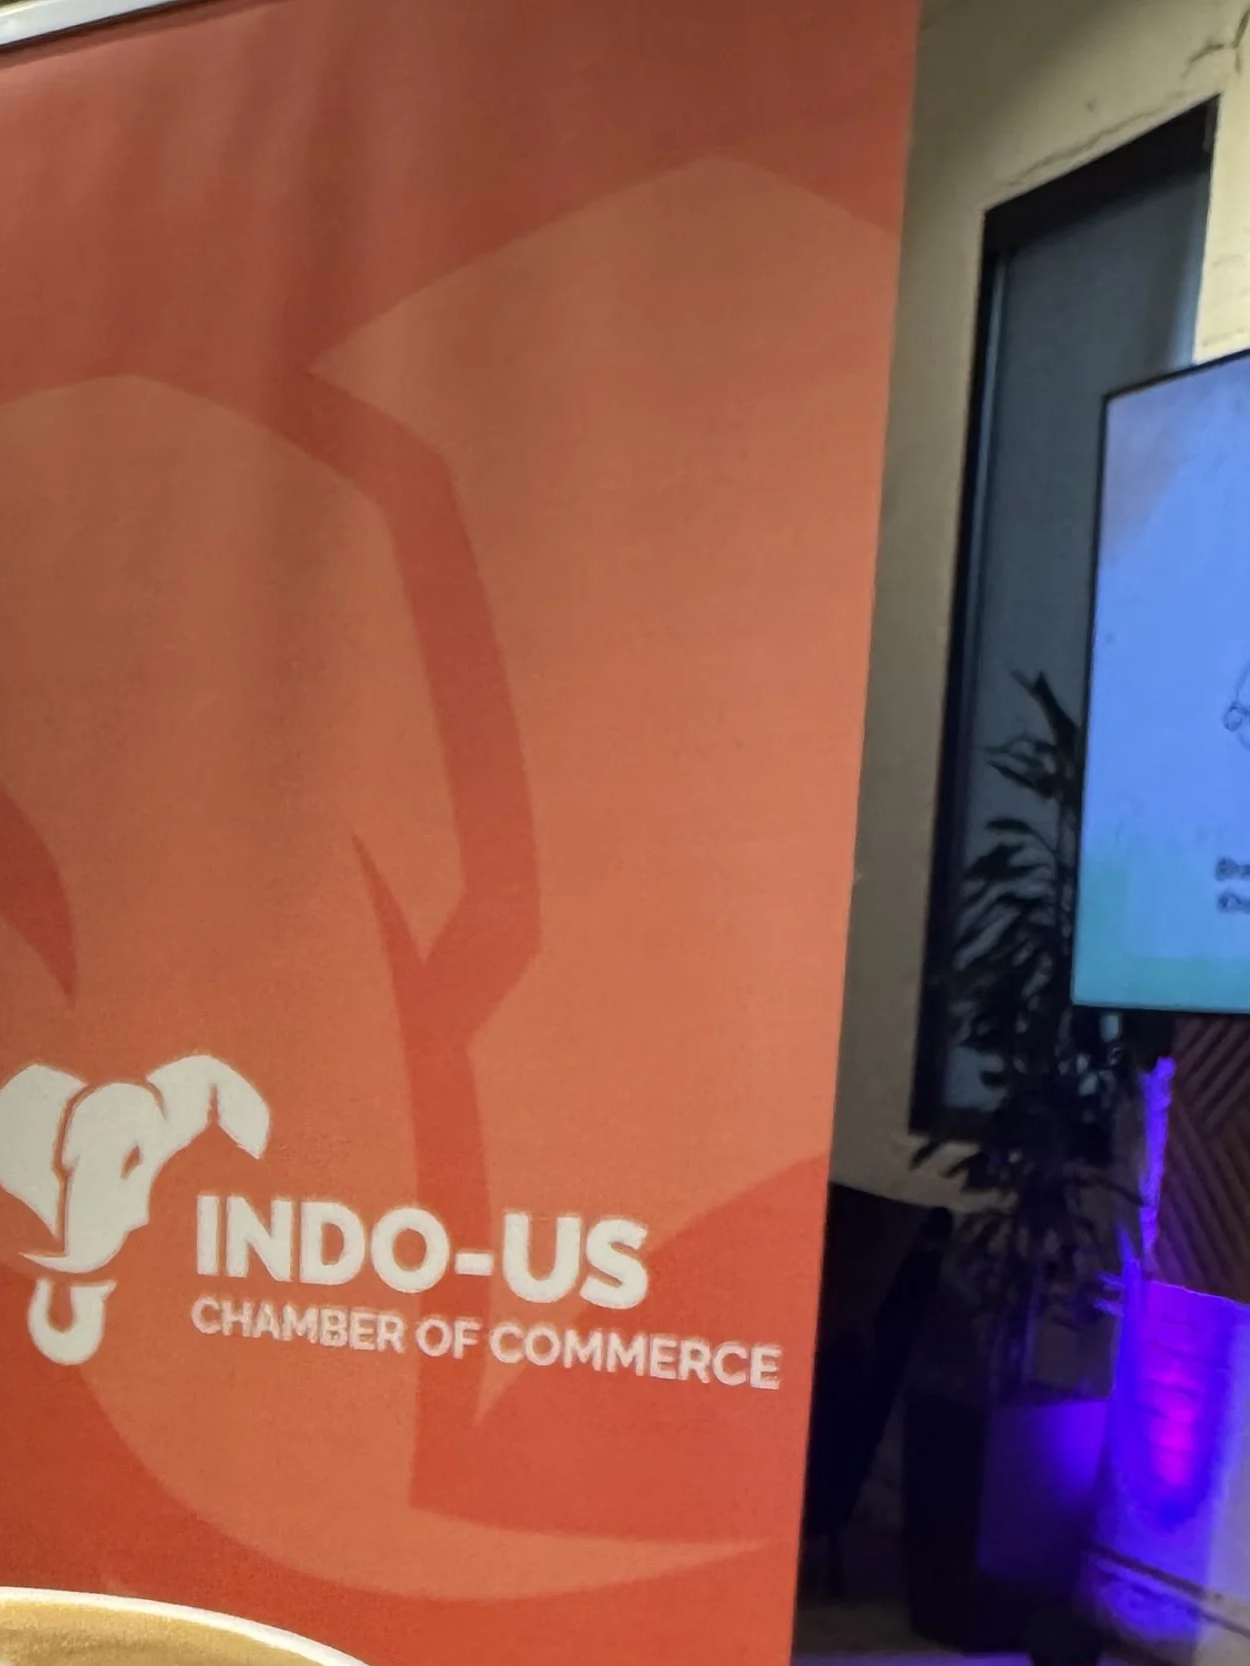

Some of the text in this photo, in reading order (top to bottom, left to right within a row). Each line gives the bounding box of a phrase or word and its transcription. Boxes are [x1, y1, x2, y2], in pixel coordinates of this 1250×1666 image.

[195, 1193, 652, 1311] INDO-US
[190, 1295, 784, 1391] CHAMBER OF COMMERCE
